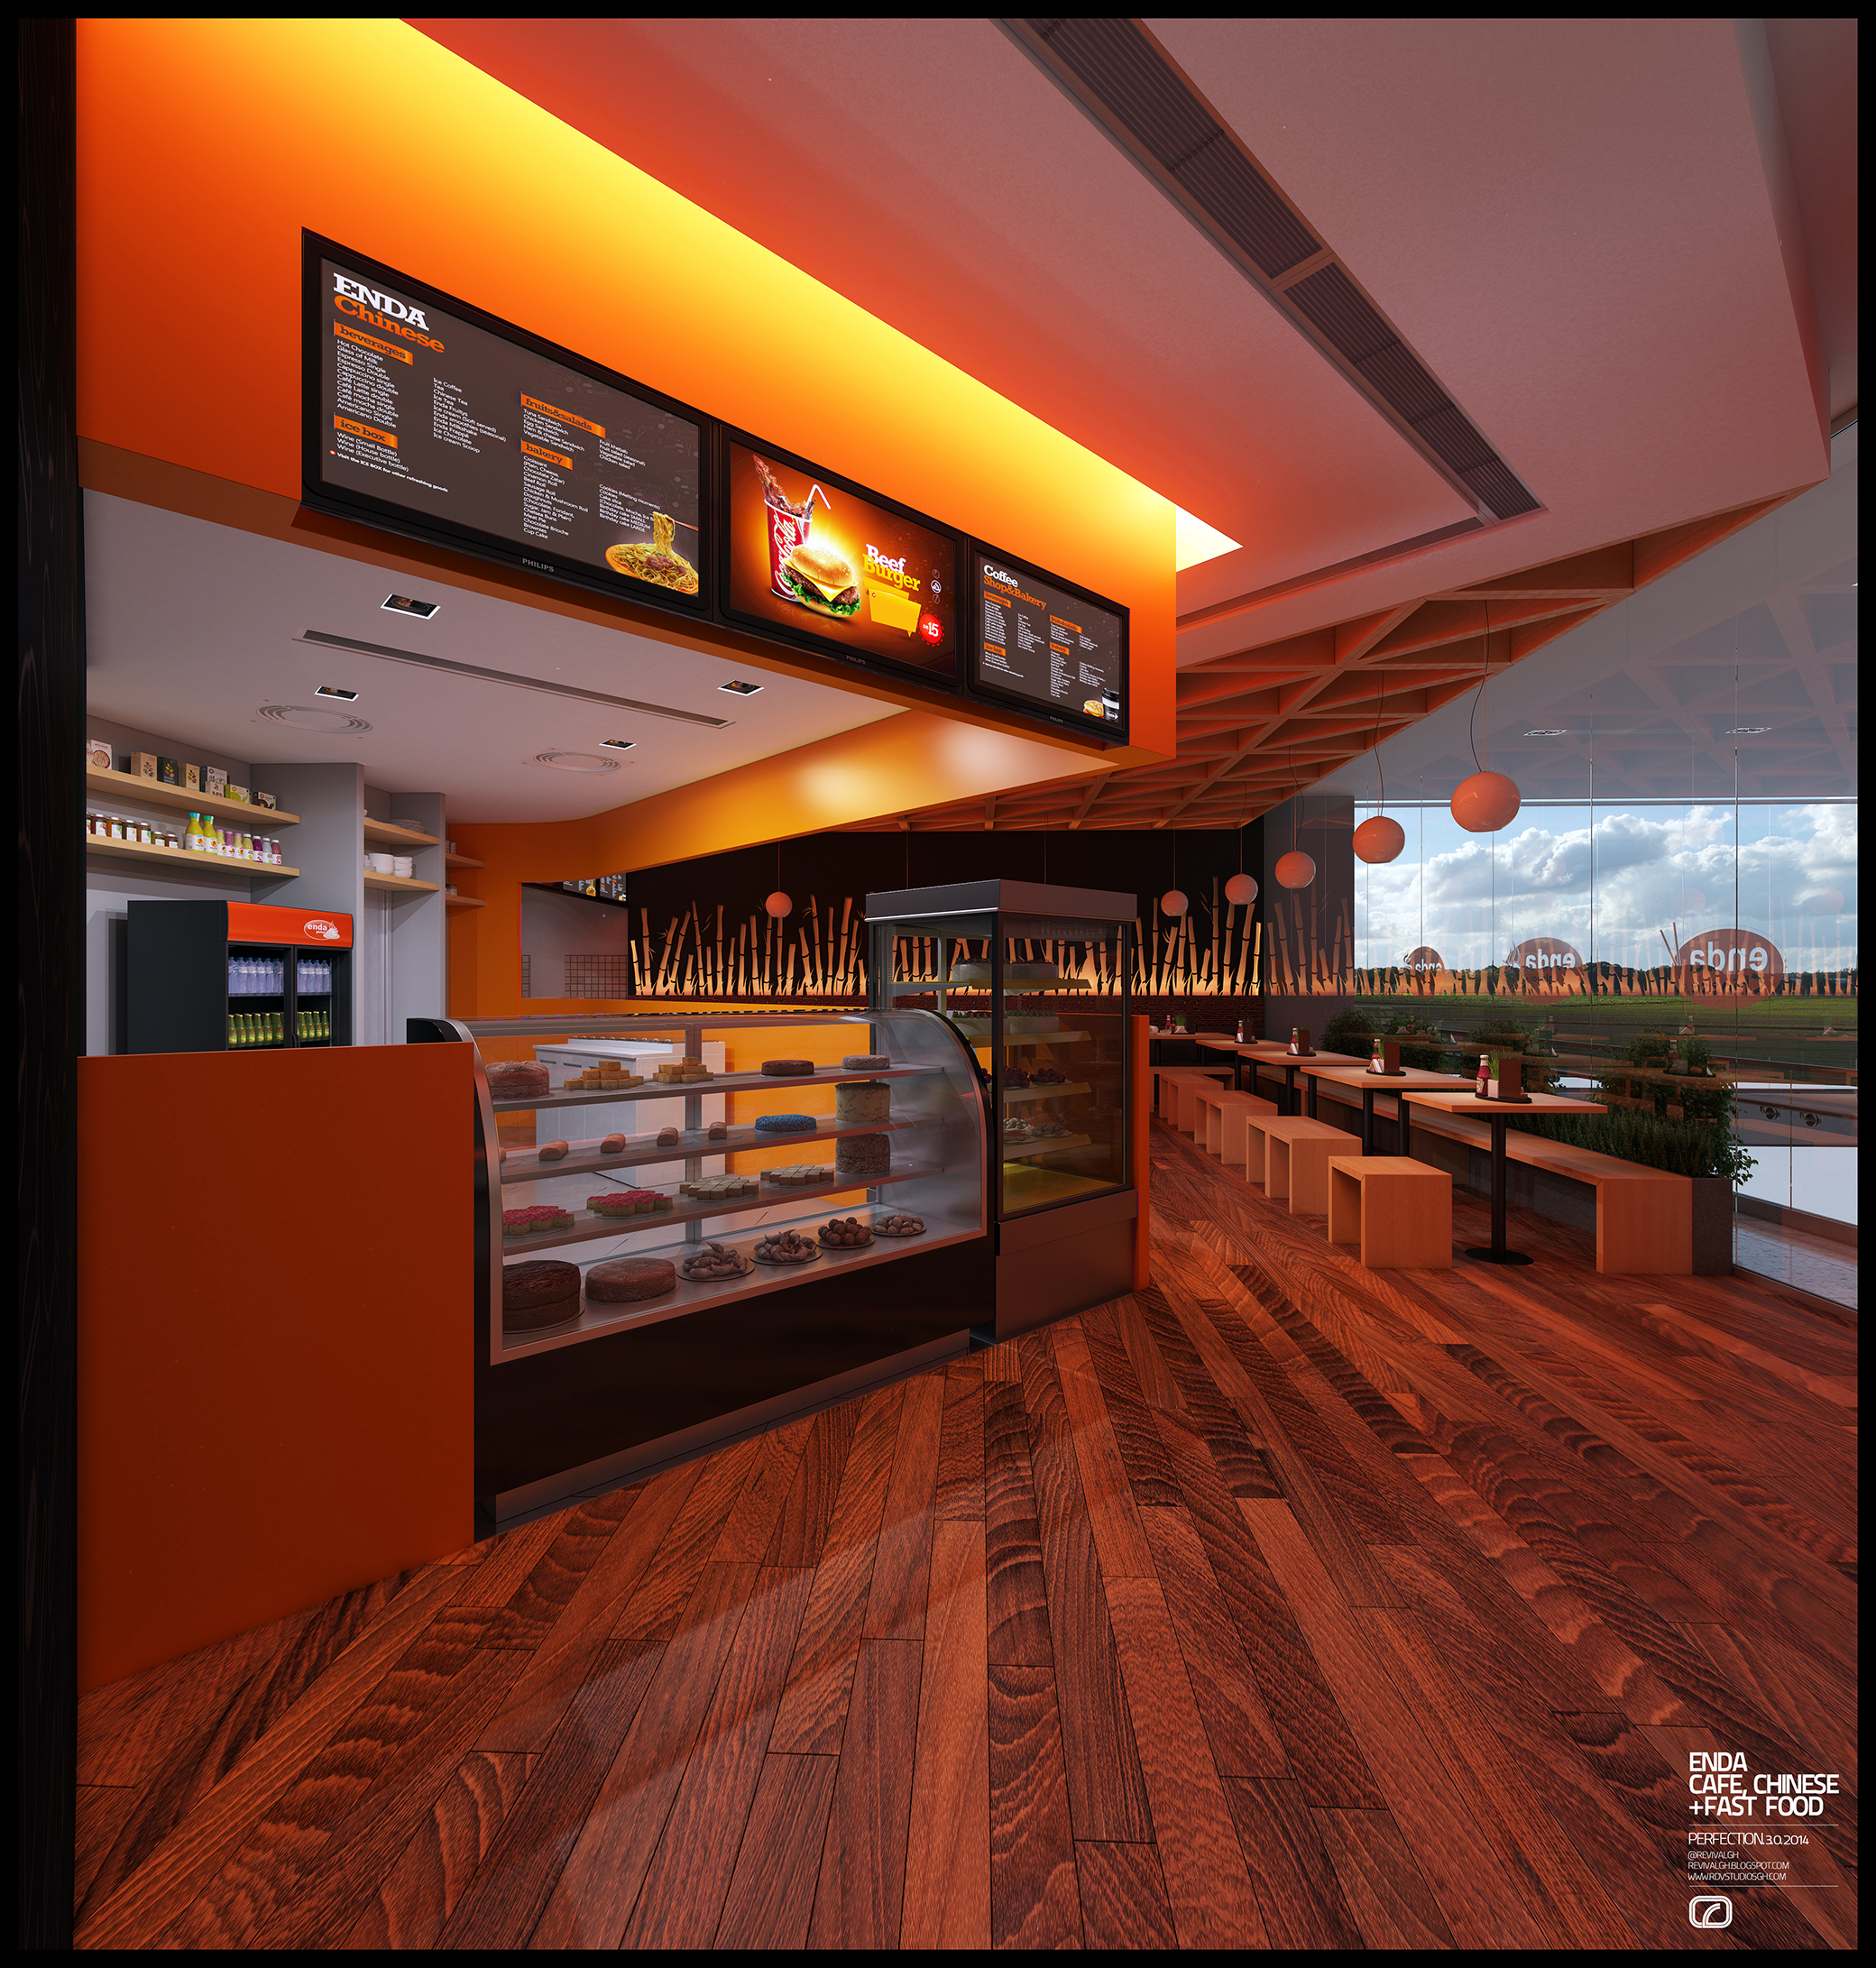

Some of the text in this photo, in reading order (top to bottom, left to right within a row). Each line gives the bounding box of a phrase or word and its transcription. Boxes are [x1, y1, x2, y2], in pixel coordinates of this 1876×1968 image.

[333, 272, 429, 331] ENDA
[335, 295, 445, 353] Chinese
[337, 339, 383, 361] Hot Chocolate
[340, 326, 406, 359] beverages
[337, 345, 354, 355] Glass
[364, 355, 378, 365] Milk
[337, 351, 386, 373] Espresso Single
[337, 356, 390, 381] Espresso Double
[337, 363, 395, 389] Cappuccino single
[337, 369, 399, 395] Cappuccino double
[337, 374, 390, 398] Café Latte single
[337, 380, 393, 404] Café Latte double
[434, 383, 445, 391] Tea
[443, 382, 462, 392] Coffee
[337, 386, 395, 411] Café mocha single
[337, 391, 399, 418] Café mocha double
[337, 398, 392, 421] Americano Single
[434, 389, 468, 406] Chinese Tea
[443, 398, 454, 406] Tea
[337, 404, 396, 428] Americano Double
[526, 399, 592, 430] fruits&salads
[341, 419, 385, 442] ice box
[337, 432, 397, 457] Wine (Small Bottle)
[337, 437, 400, 464] Wine (House bottle)
[526, 444, 563, 464] bakery
[337, 444, 409, 472] Wine (Executive bottle)
[407, 476, 432, 488] refreshing
[522, 558, 555, 573] PHILIPS
[866, 543, 906, 575] Beef
[862, 553, 921, 592] Burger
[983, 565, 1018, 588] Coffee
[983, 575, 1047, 611] Shop&Bakery
[928, 621, 939, 637] 15
[846, 655, 866, 666] PHILIPS
